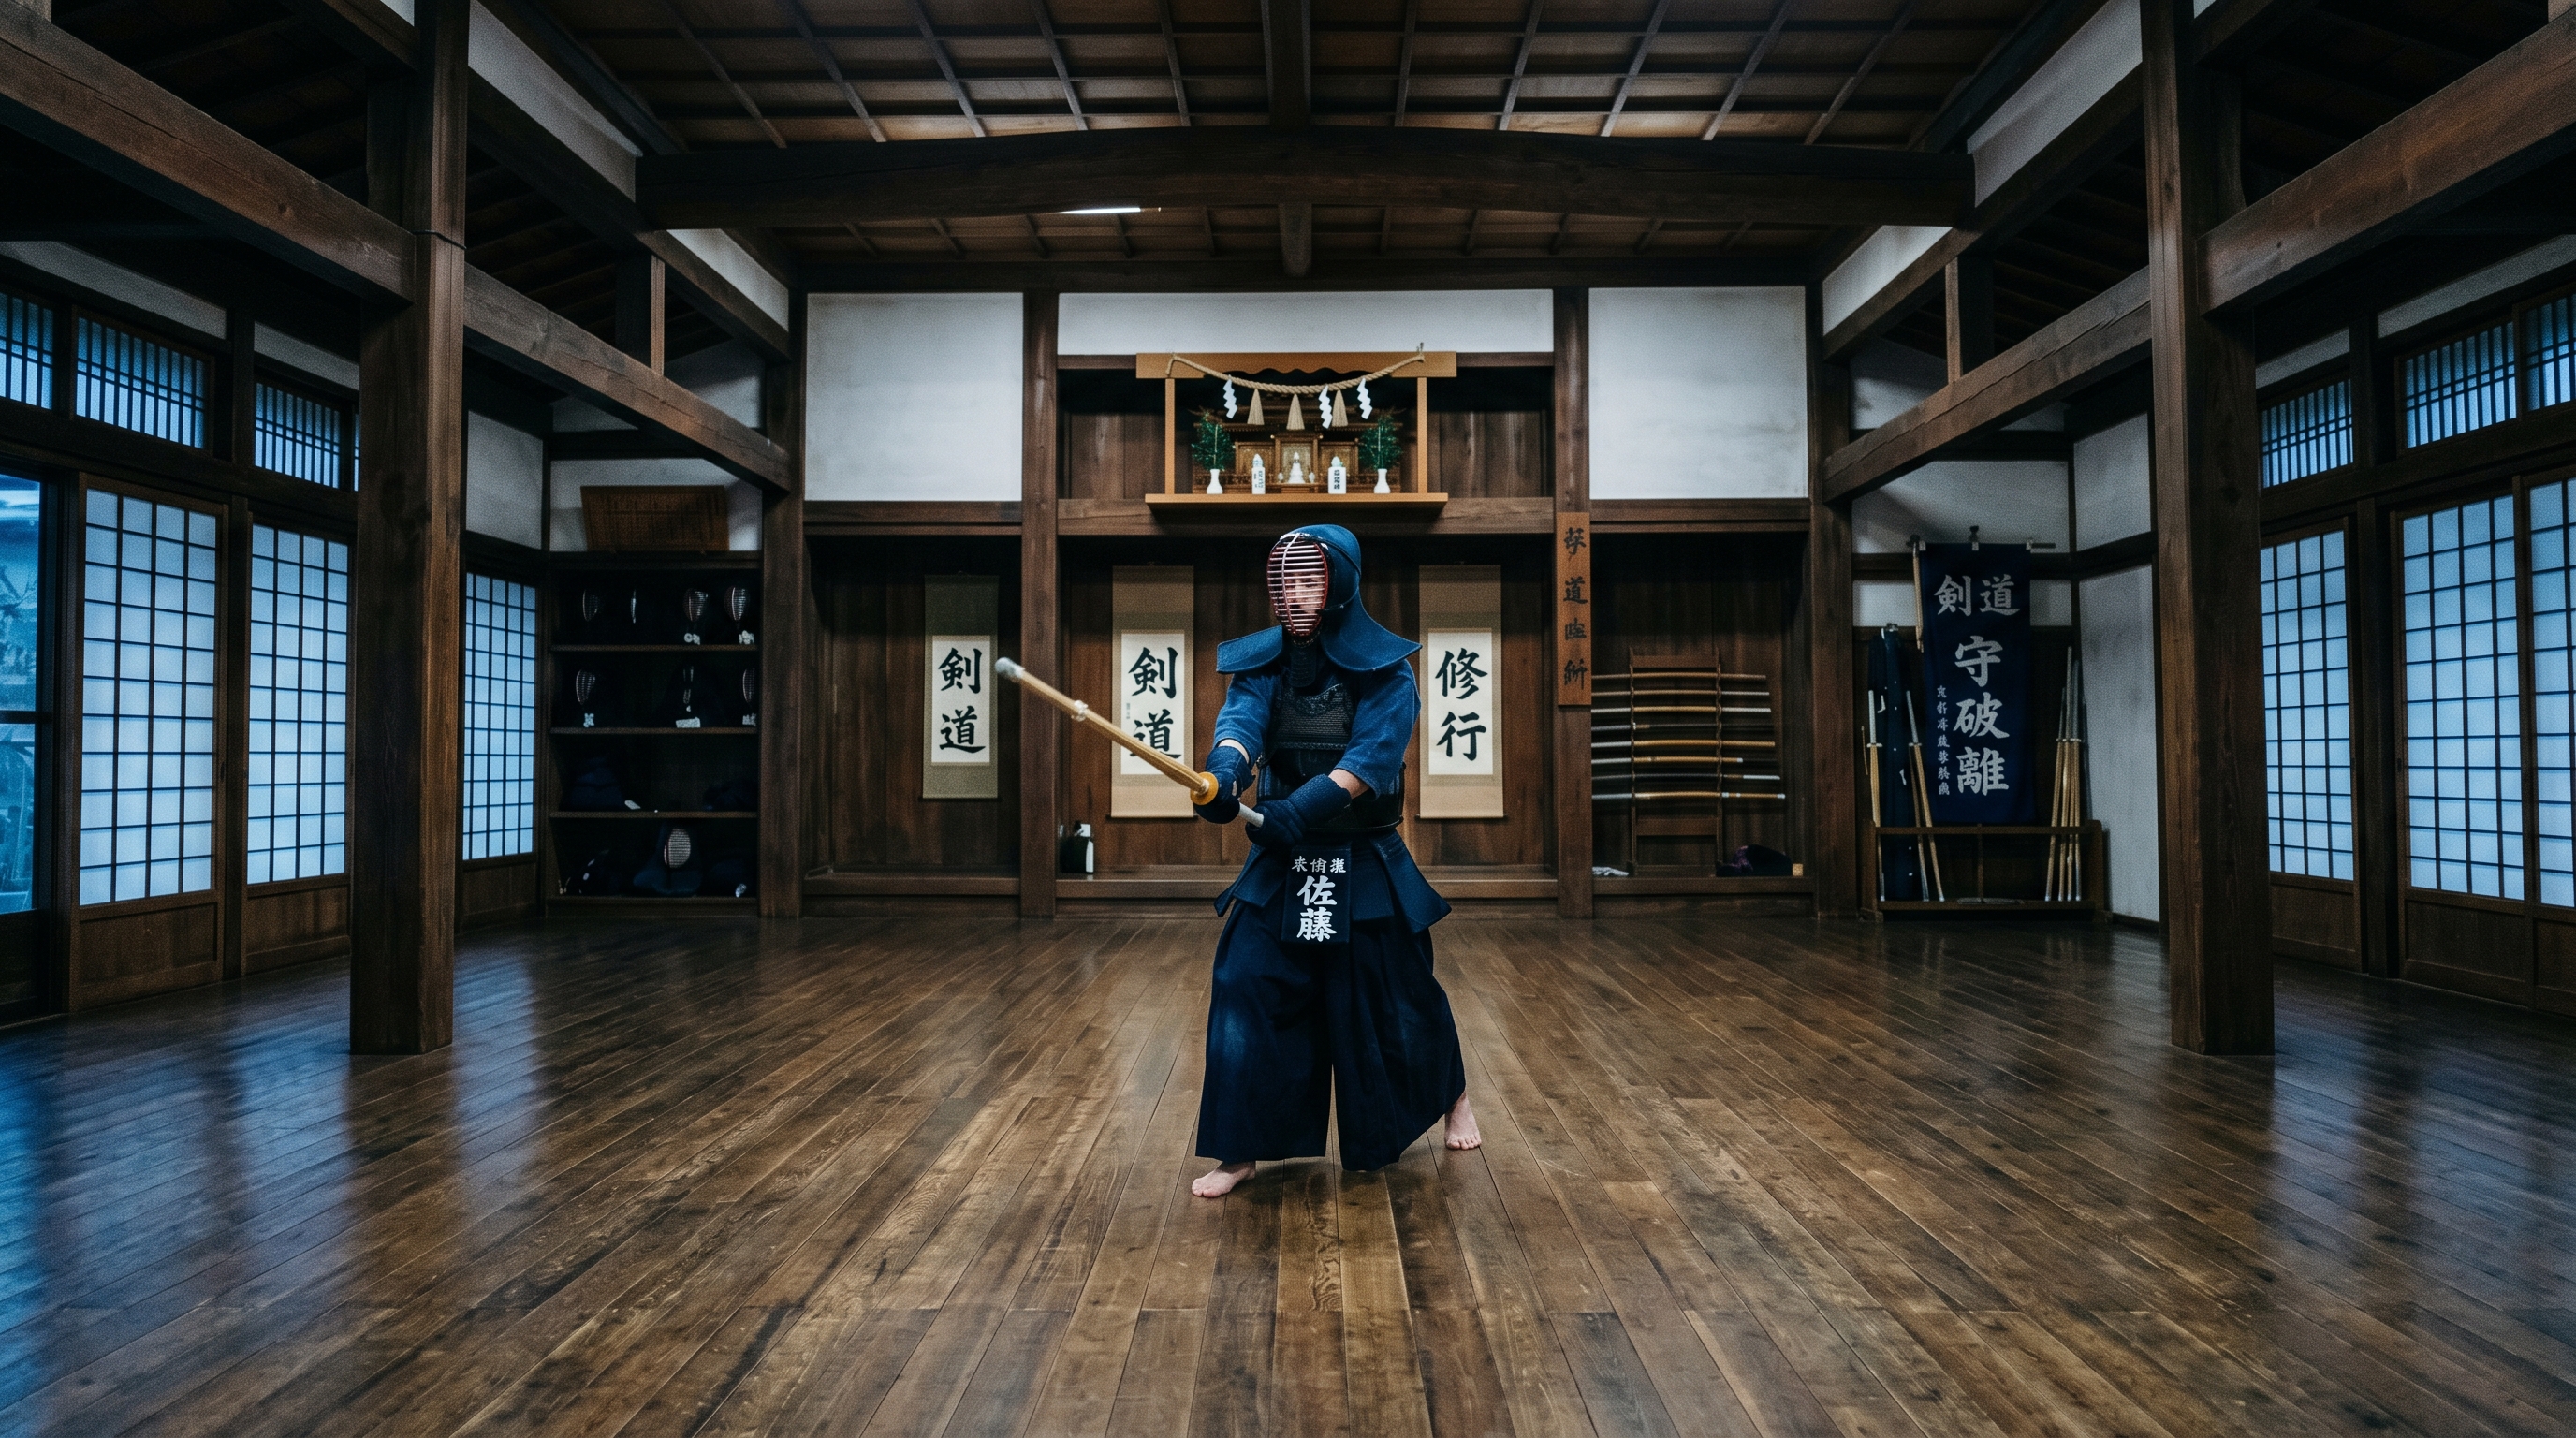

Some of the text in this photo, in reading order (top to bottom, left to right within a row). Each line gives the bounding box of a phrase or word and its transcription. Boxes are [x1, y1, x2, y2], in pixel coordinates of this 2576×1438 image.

[1933, 574, 2021, 617] 剣道
[938, 647, 986, 755] 剣道
[1127, 646, 1181, 759] 剣道
[1434, 647, 1489, 761] 修行
[1953, 635, 2011, 797] 守破離
[1296, 874, 1338, 942] 佐藤
